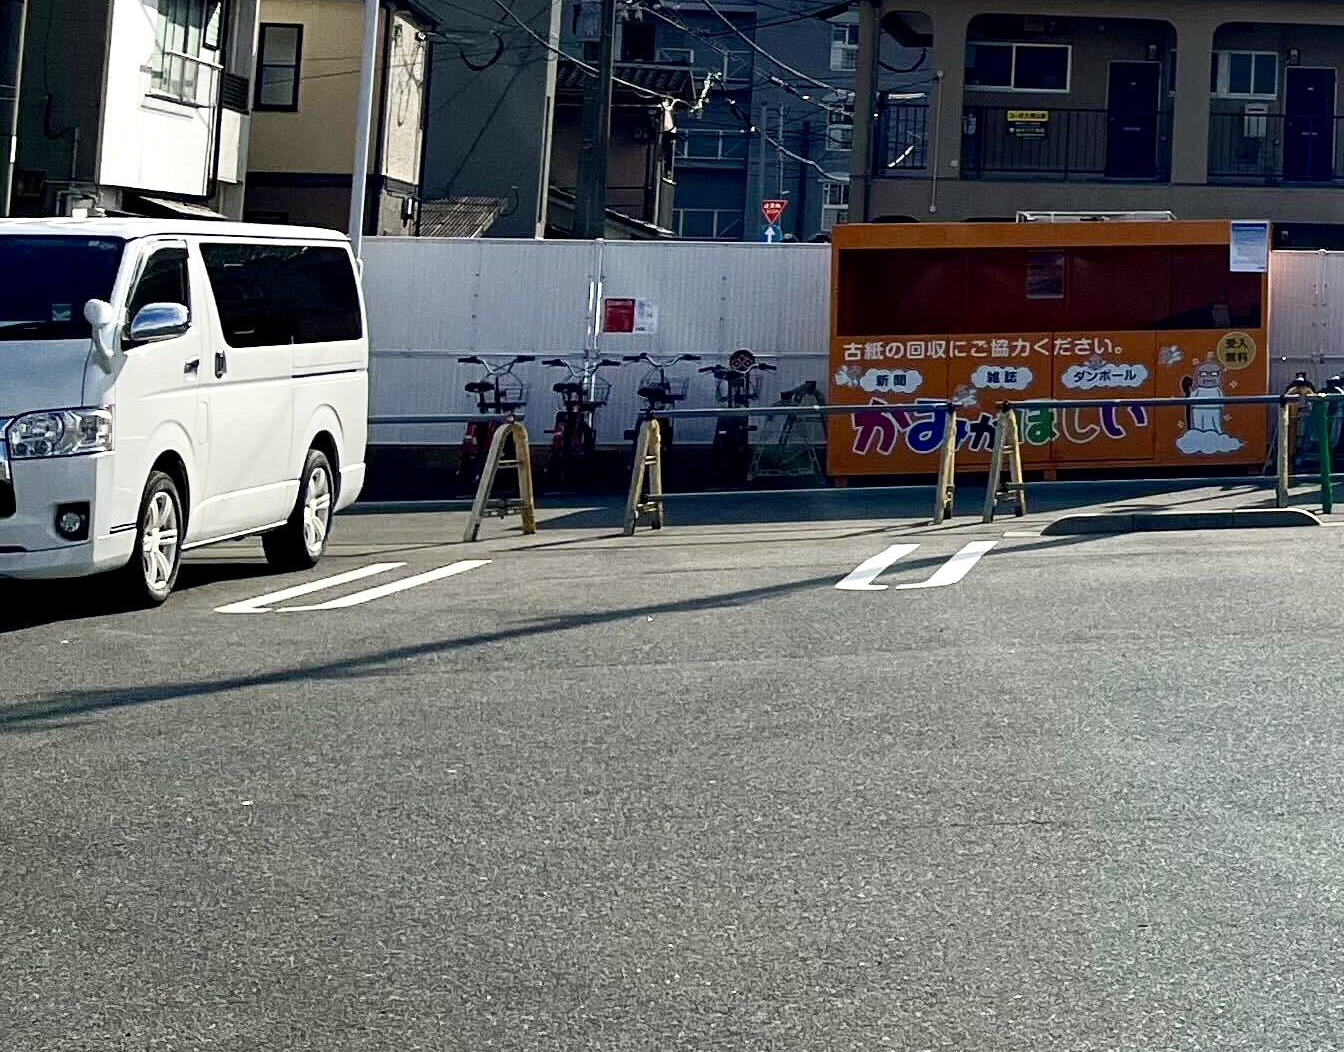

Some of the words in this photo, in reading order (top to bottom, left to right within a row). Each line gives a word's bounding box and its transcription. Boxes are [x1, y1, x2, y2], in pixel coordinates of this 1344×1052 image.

[843, 337, 1123, 361] 古紙の回収にご協力ください。
[876, 374, 907, 387] 新聞
[986, 371, 1018, 384] 雑誌
[1073, 369, 1137, 384] ダンボール
